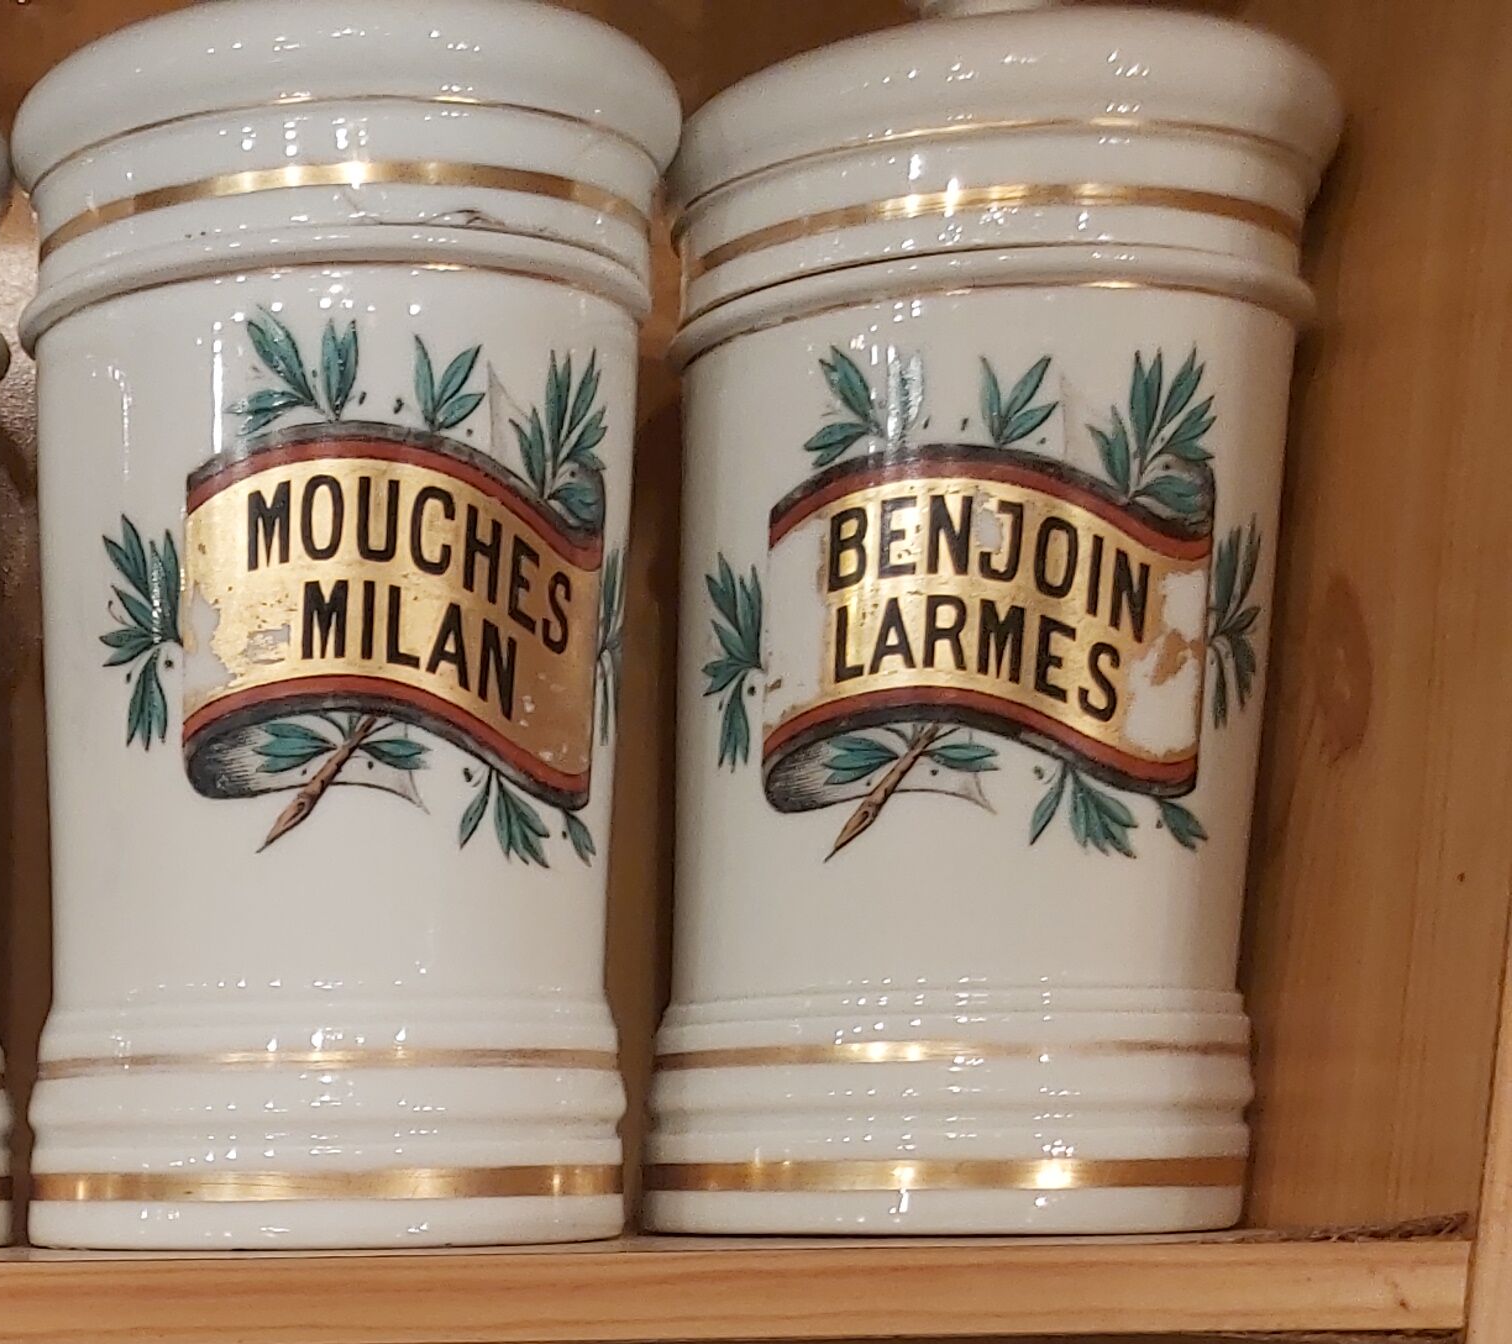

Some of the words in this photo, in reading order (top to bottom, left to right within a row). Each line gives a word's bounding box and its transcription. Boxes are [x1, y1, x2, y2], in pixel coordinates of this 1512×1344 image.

[247, 474, 572, 655] MOUCHES
[827, 494, 1150, 643] BENJOIN
[301, 579, 518, 721] MILAN
[833, 594, 1121, 722] LARMES
